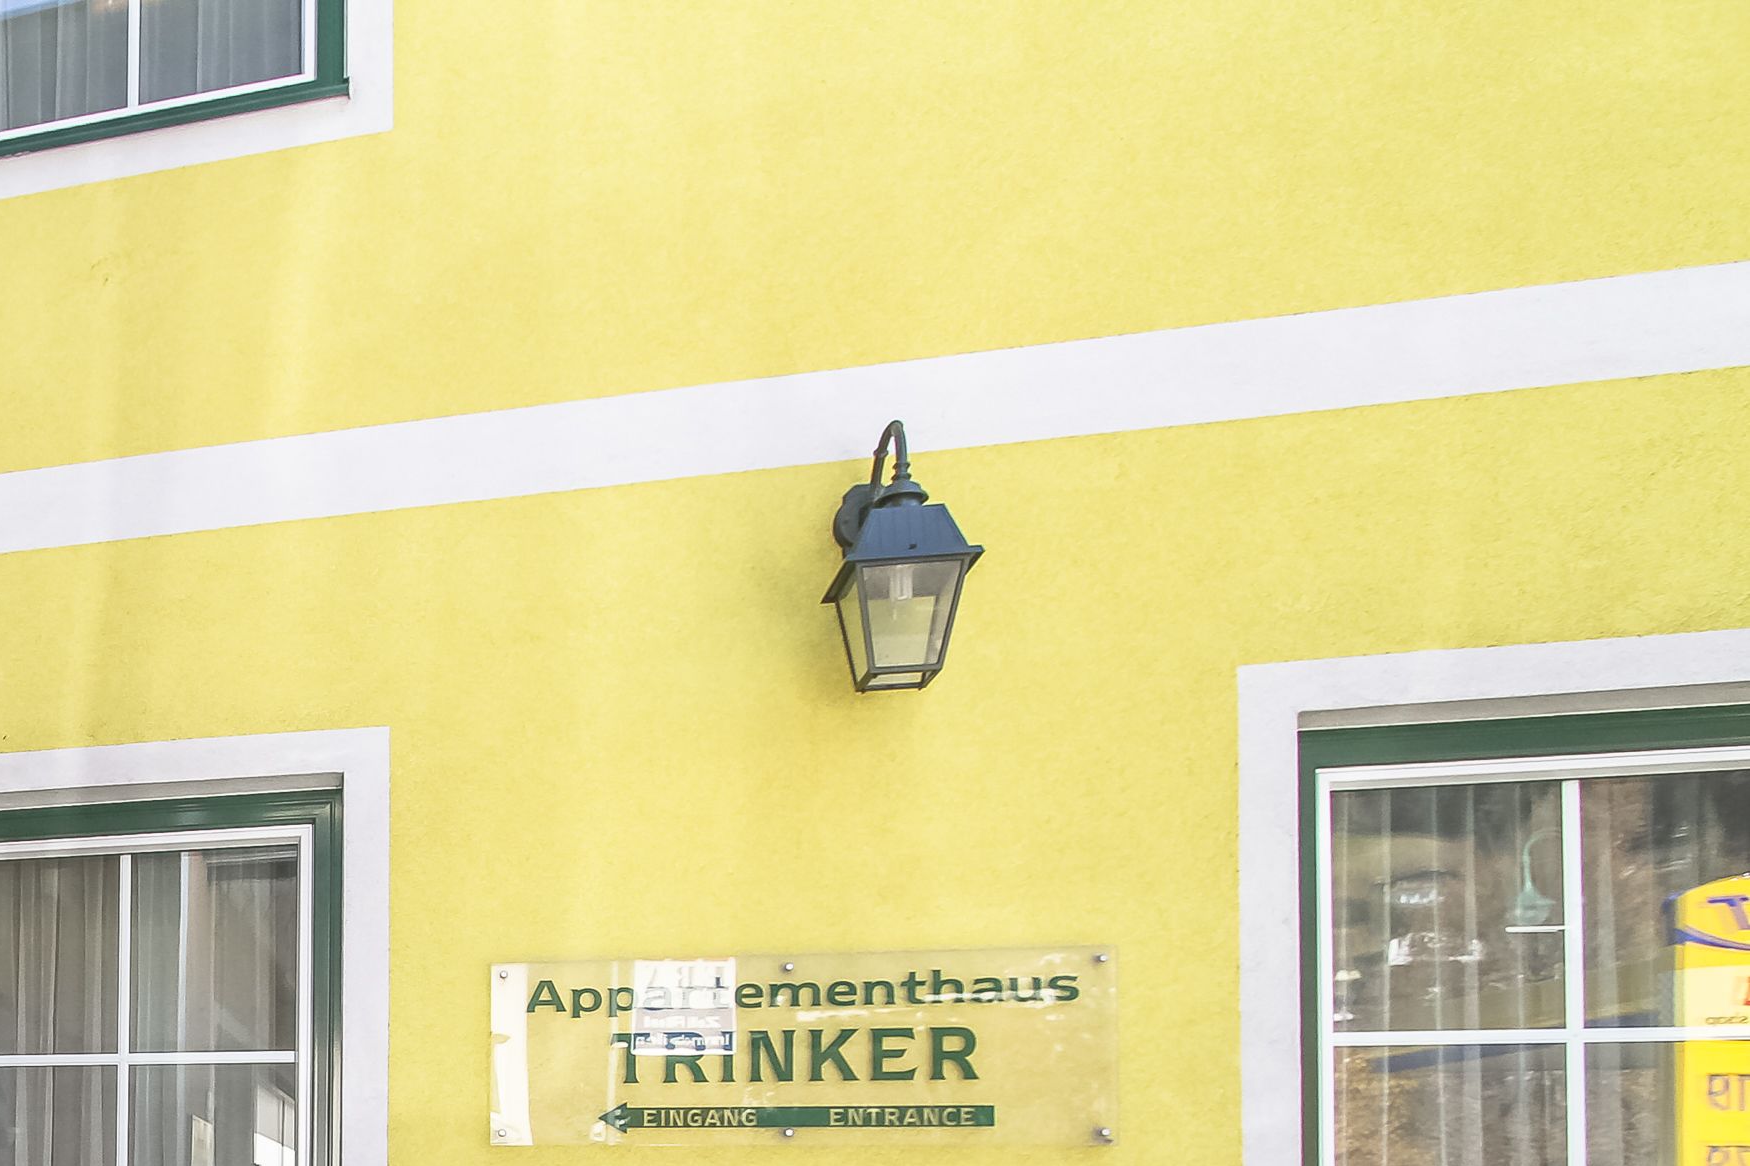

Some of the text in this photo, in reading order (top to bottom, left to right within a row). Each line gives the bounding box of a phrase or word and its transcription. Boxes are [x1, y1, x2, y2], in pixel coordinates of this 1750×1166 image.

[525, 969, 1080, 1019] Appartementhaus
[611, 1026, 980, 1085] TRINKER
[642, 1106, 976, 1128] EINGANG ENTRANCE
